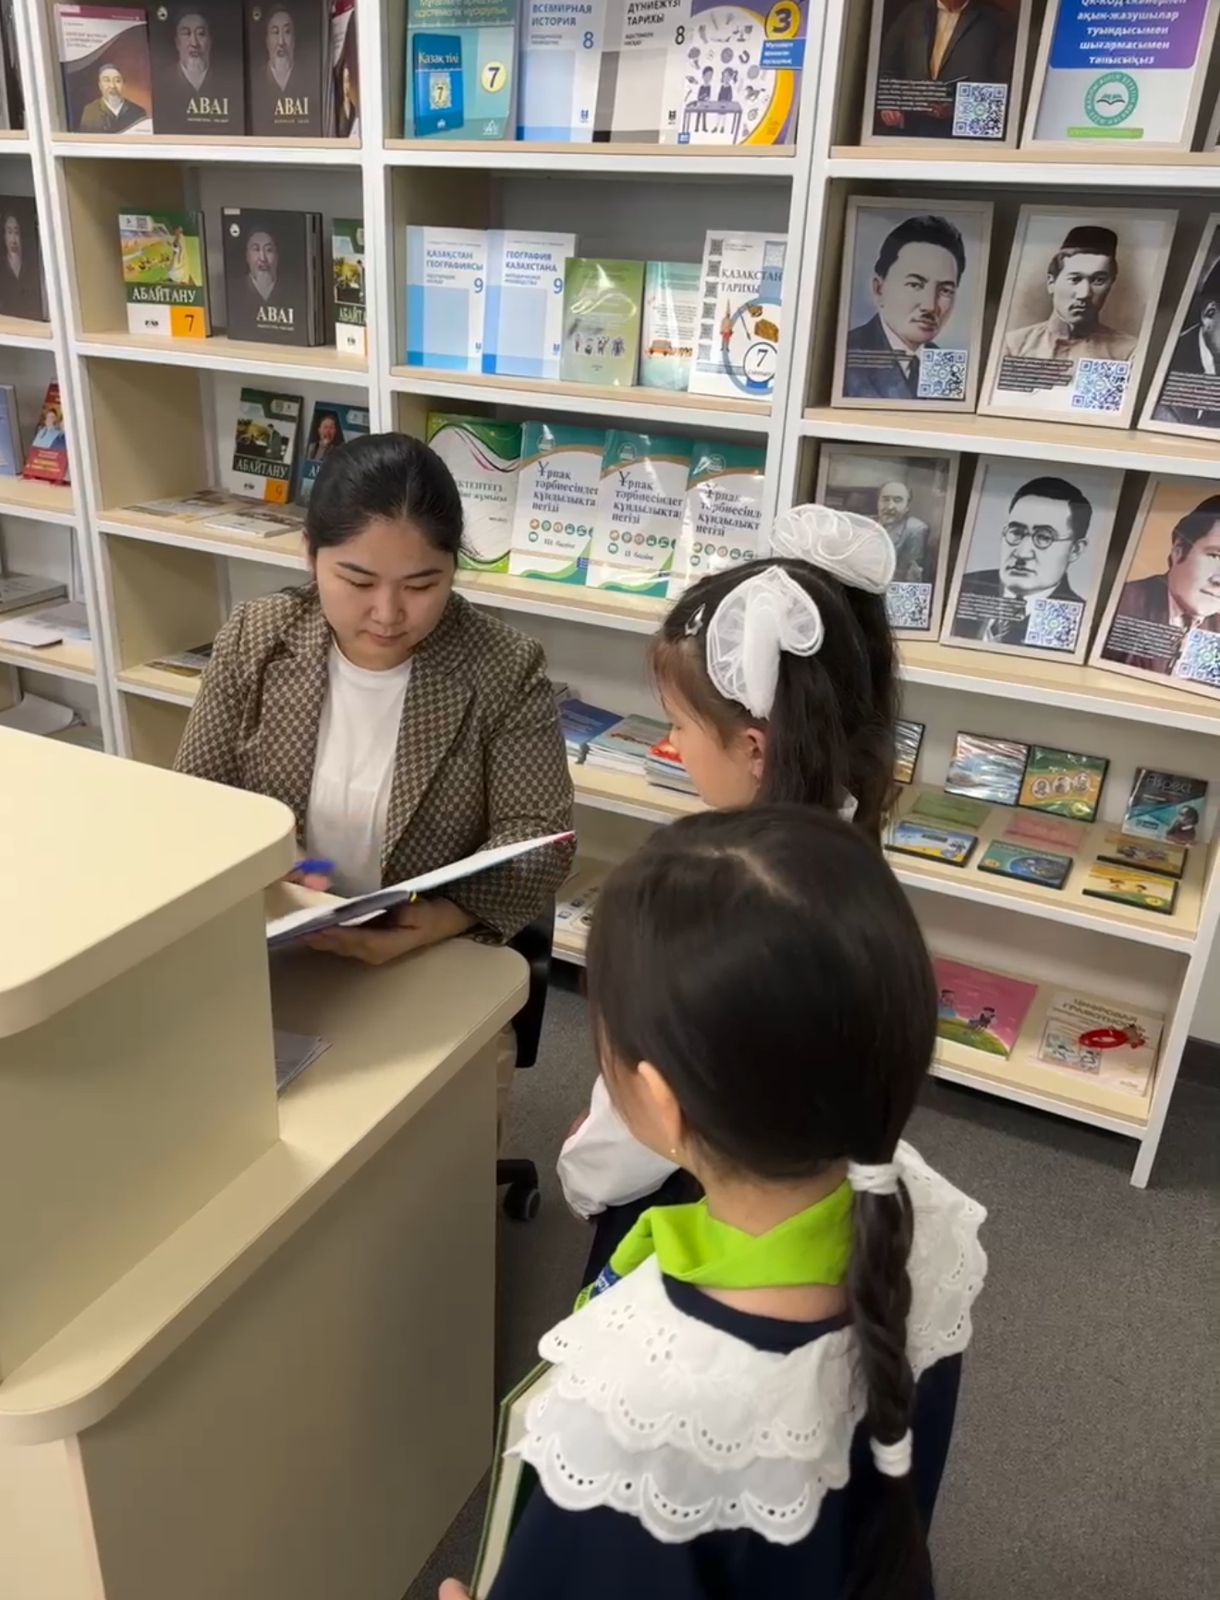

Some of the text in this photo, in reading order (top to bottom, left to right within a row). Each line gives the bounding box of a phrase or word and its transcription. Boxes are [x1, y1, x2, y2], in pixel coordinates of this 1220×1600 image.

[532, 3, 593, 14] ВСЕМИРНАЯ
[531, 16, 577, 26] ИСТОРИЯ
[627, 13, 665, 26] ТАРИХЫ
[772, 7, 793, 34] 3
[583, 31, 594, 49] 8
[675, 25, 685, 45] 8
[488, 66, 500, 89] 7
[437, 86, 444, 101] 7
[505, 250, 552, 260] ГЕОГРАФИЯ
[426, 260, 484, 271] ГЕОГРАФИЯСЫ
[505, 261, 558, 272] КАЗАХСТАНА
[473, 277, 484, 294] 9
[553, 277, 563, 294] 9
[721, 282, 761, 294] ТАРИХЫ
[132, 286, 196, 303] АБАЙТАНУ
[184, 313, 195, 332] 7
[757, 348, 769, 368] 7
[237, 459, 289, 478] АБАЙТАНУ
[535, 479, 599, 496] тәрбиесіндег
[615, 489, 683, 507] тәрбиесіндег
[531, 502, 560, 514] негізі
[611, 512, 641, 524] негізі
[695, 524, 726, 537] негізі
